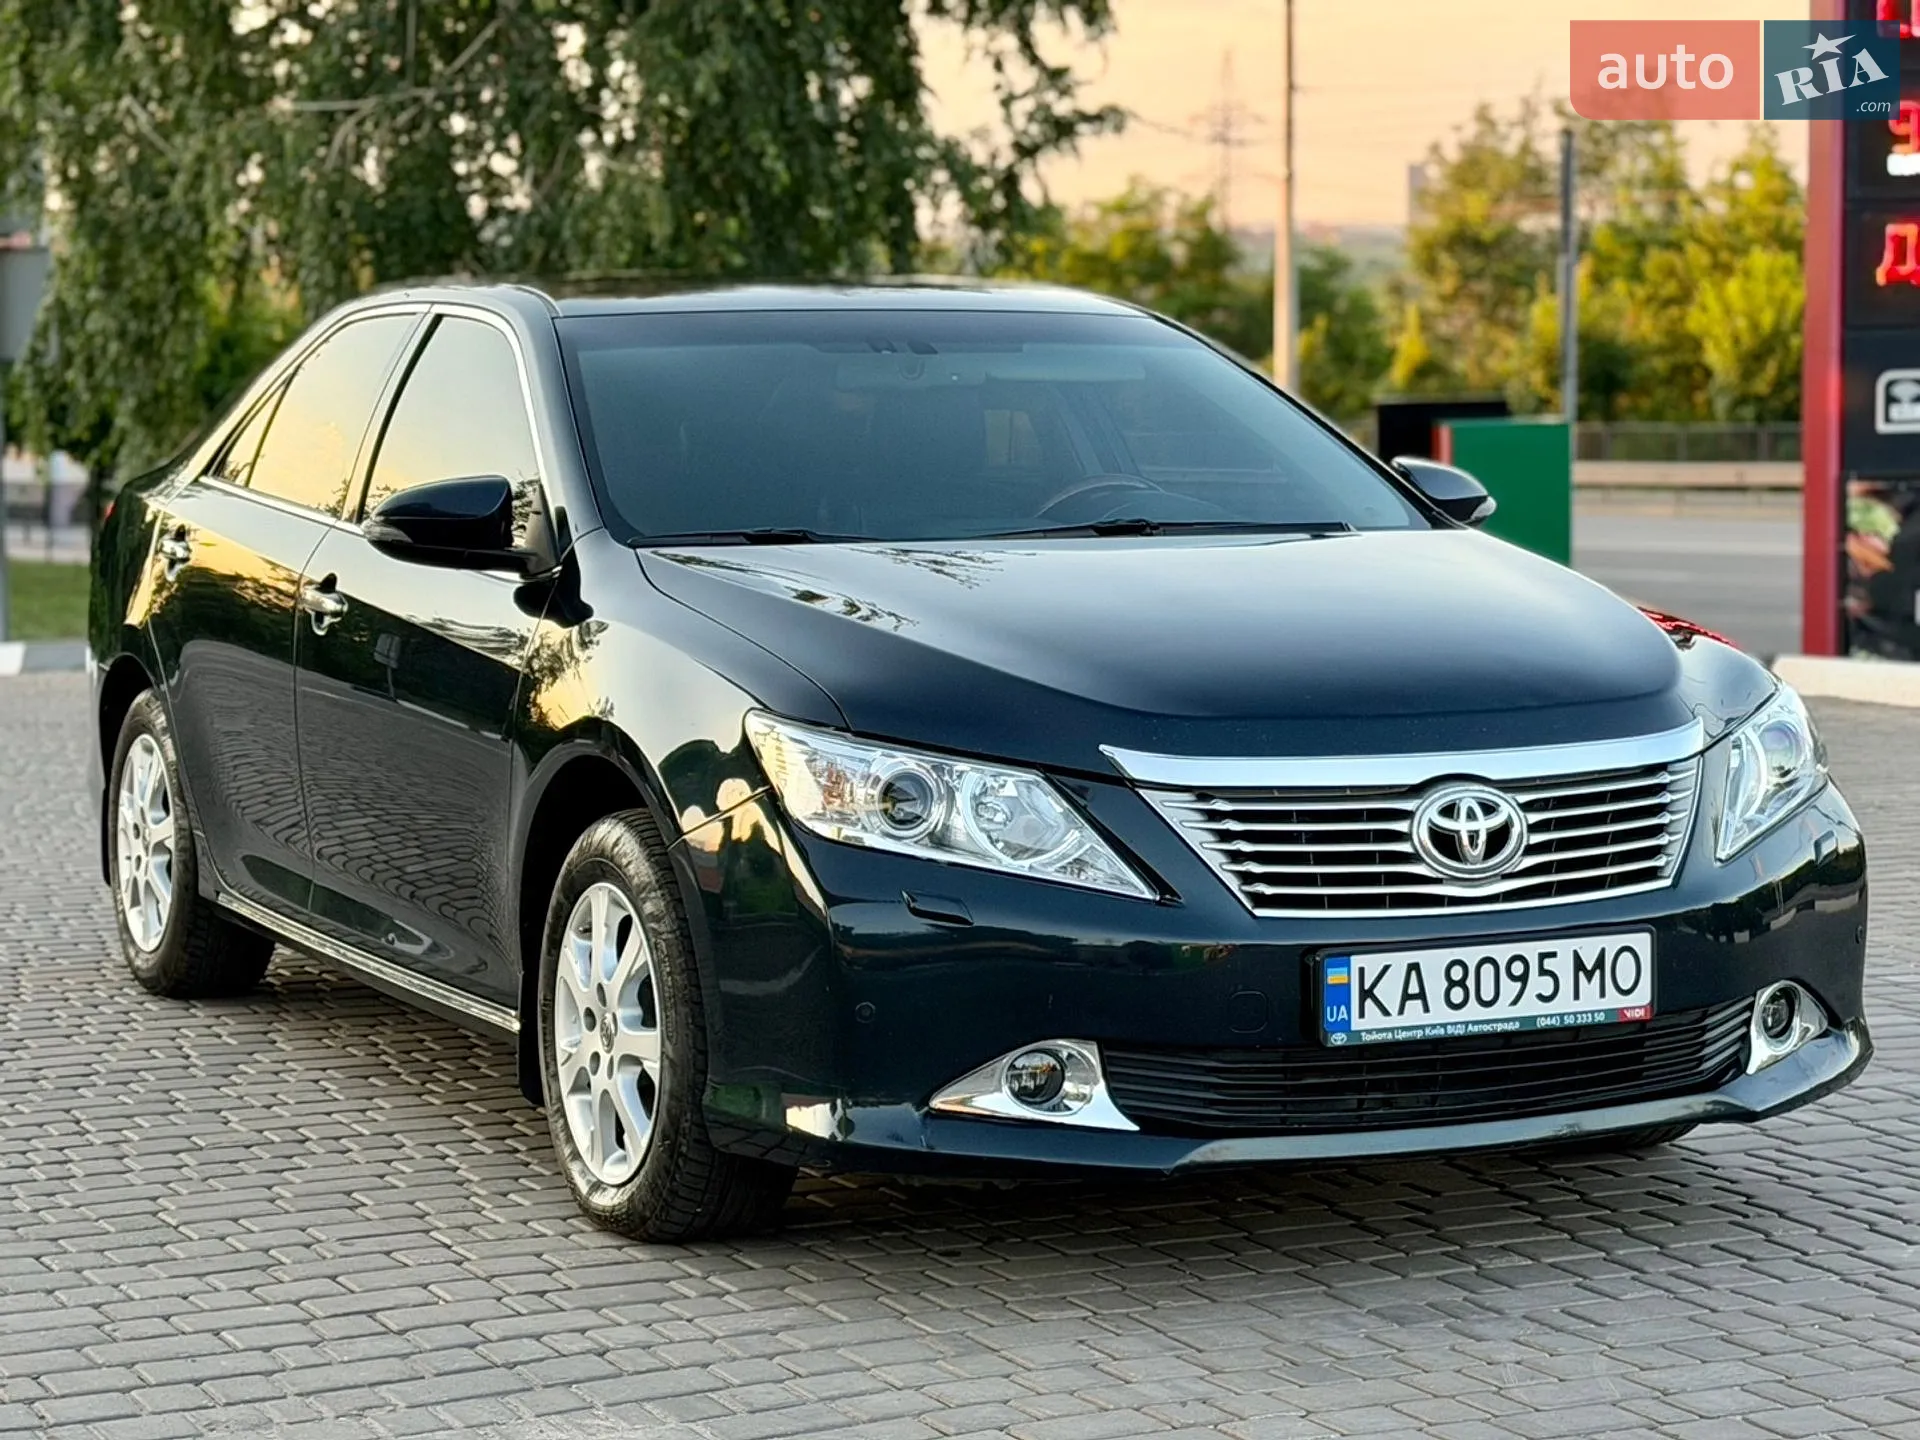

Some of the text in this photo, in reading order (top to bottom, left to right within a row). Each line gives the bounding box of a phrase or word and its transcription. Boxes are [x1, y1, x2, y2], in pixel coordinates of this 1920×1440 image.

[1358, 945, 1642, 1020] KA 8095 MO
[1326, 1005, 1348, 1022] UA
[1360, 1030, 1393, 1042] Тойота
[1395, 1027, 1423, 1041] Центр
[1467, 1020, 1520, 1033] Автострада
[1536, 1016, 1560, 1028] (044)
[1563, 1014, 1575, 1025] 50
[1576, 1013, 1591, 1024] 333
[1593, 1012, 1605, 1022] 50
